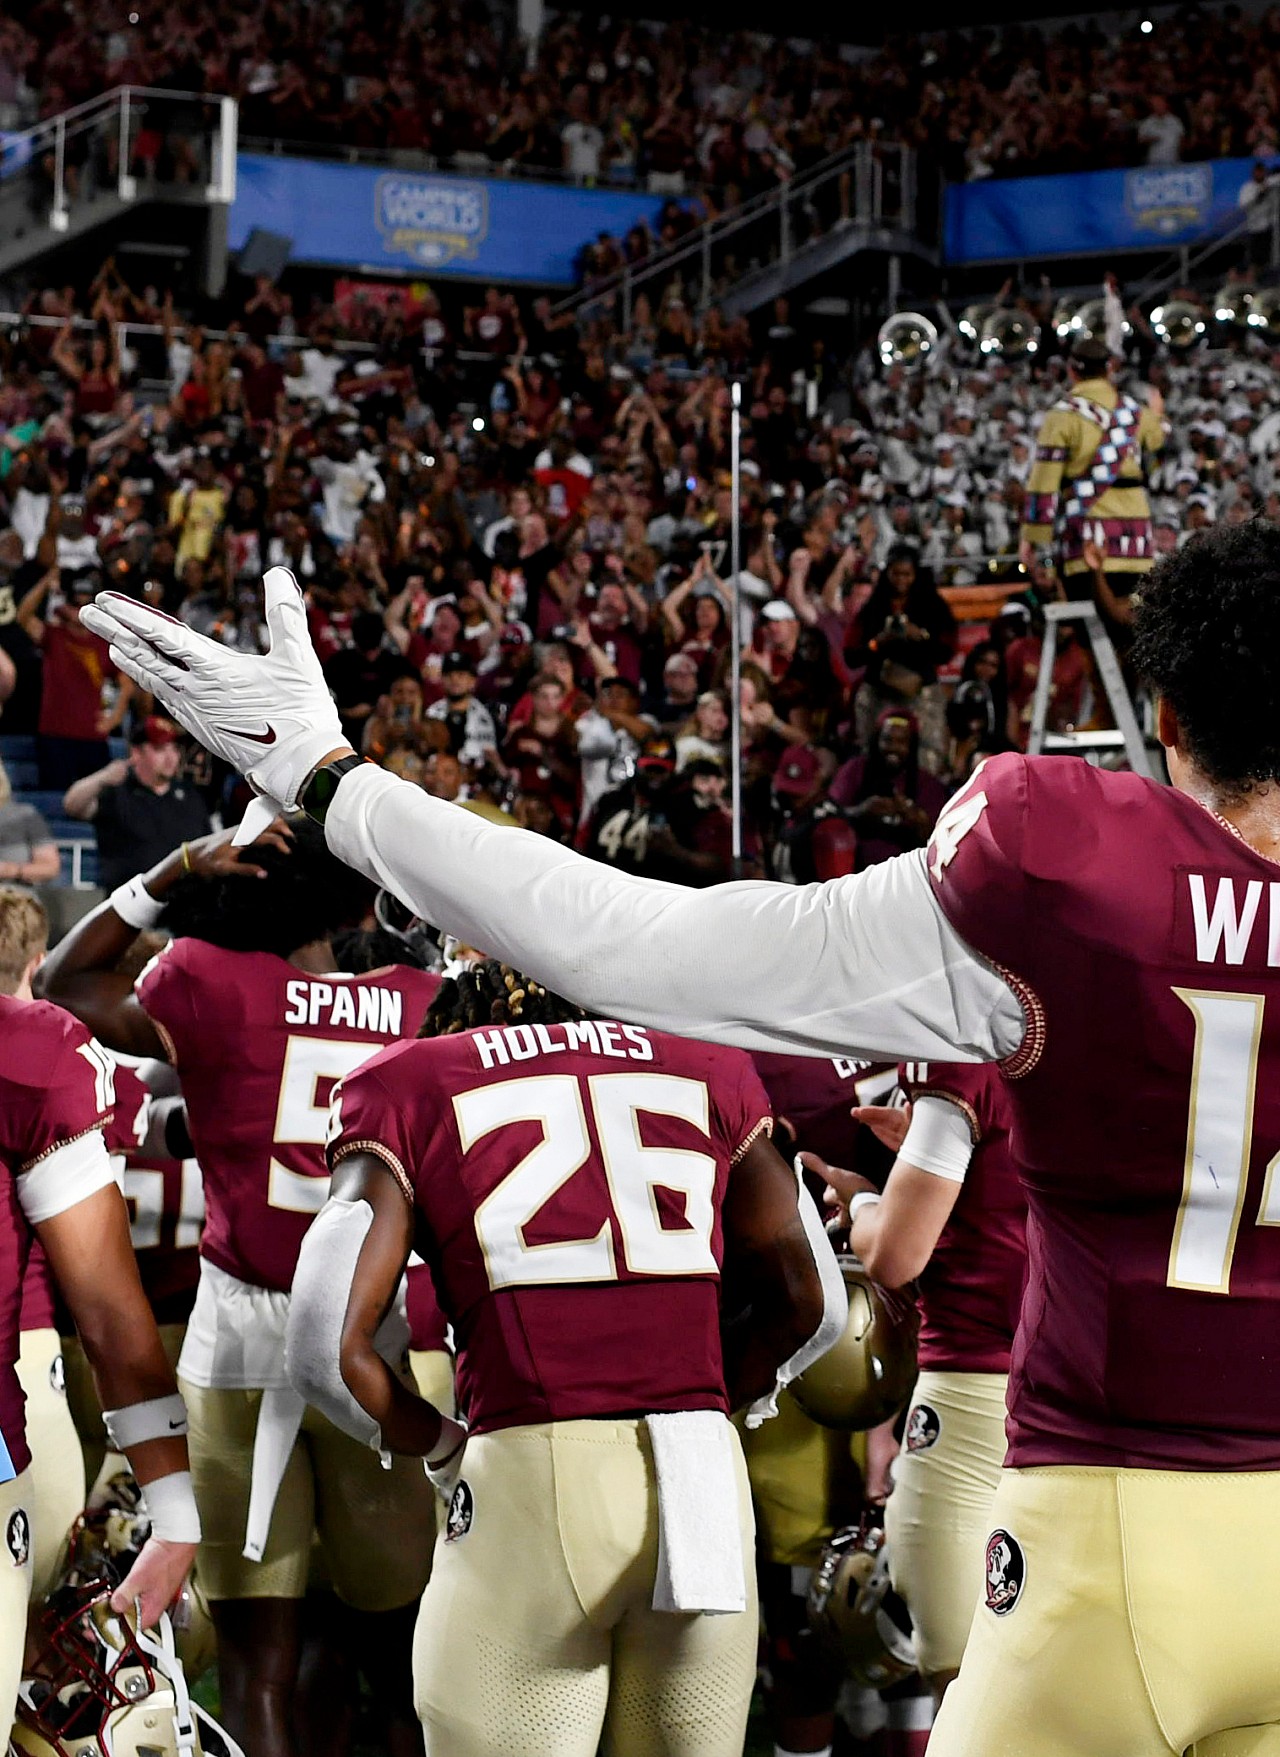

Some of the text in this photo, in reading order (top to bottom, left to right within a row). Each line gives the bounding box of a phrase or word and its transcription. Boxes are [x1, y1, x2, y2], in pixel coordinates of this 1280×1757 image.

[597, 808, 650, 862] 44
[285, 980, 402, 1036] SPANN
[471, 1020, 654, 1069] HOLMES
[451, 1072, 721, 1292] 26
